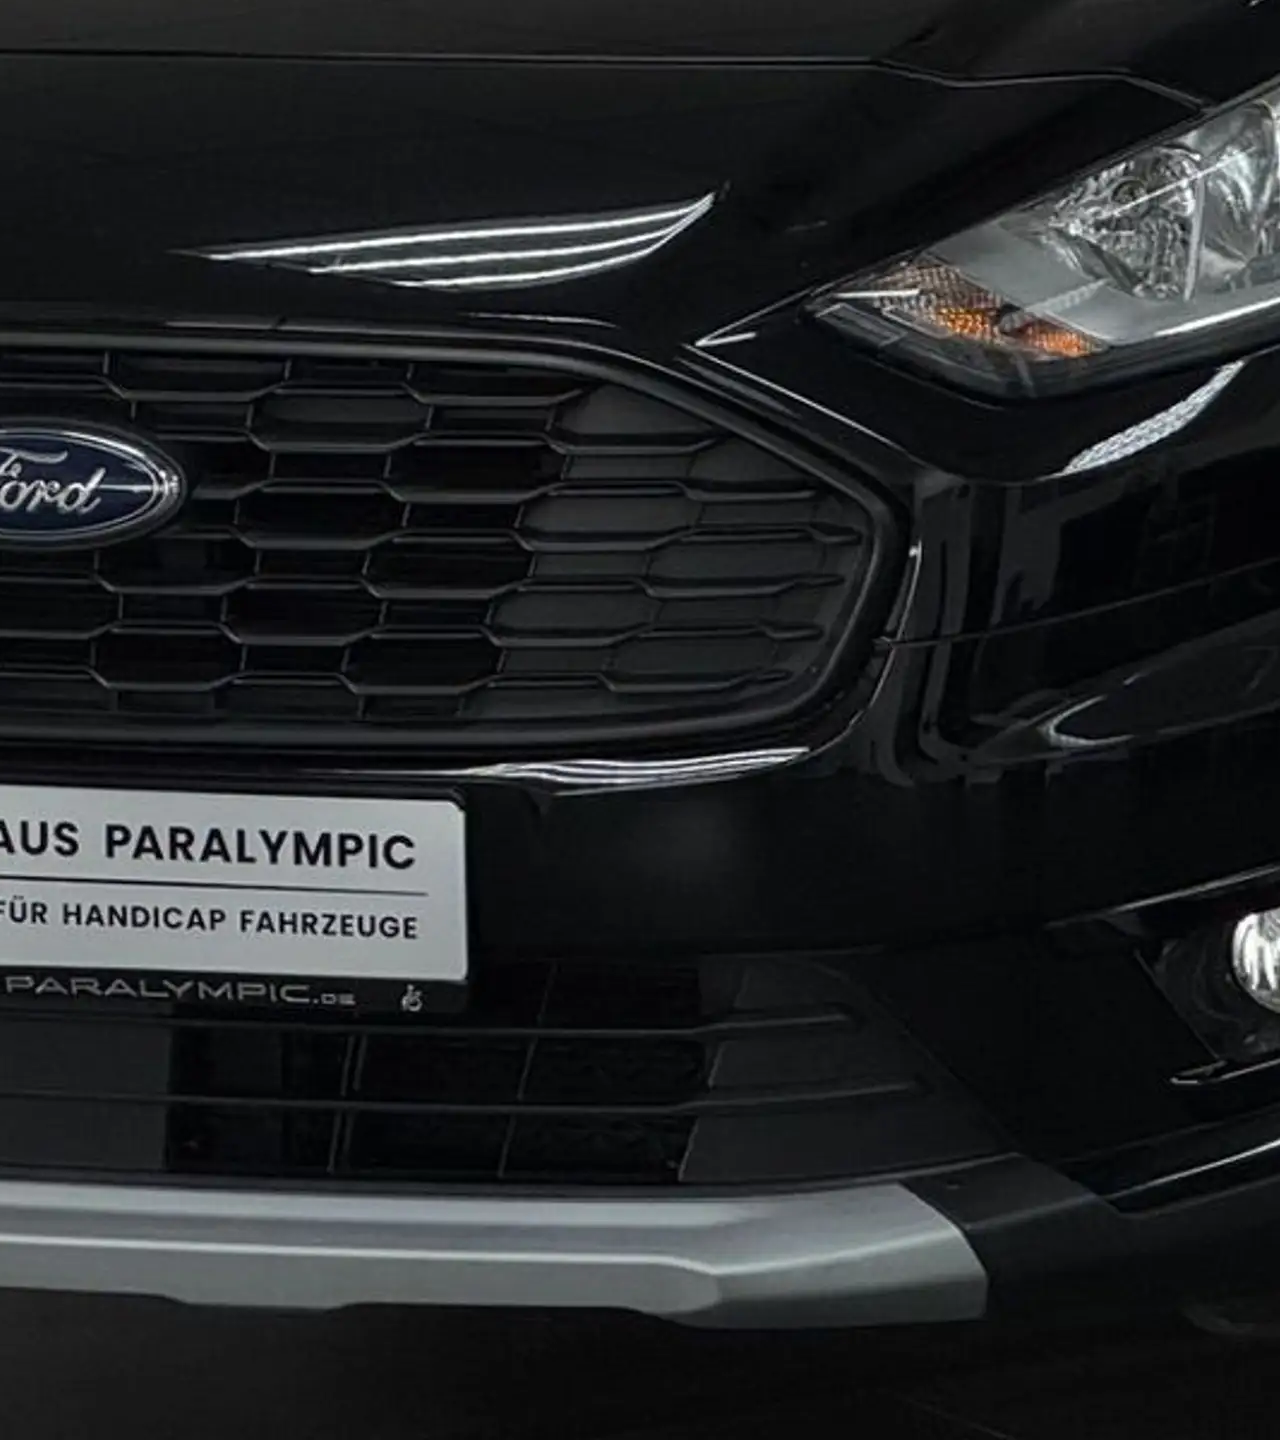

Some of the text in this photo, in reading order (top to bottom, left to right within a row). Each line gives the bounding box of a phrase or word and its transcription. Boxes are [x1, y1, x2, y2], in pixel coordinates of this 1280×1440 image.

[104, 823, 416, 870] PARALYMPIC
[62, 903, 227, 933] HANDICAP
[239, 909, 419, 940] FAHRZEUGE
